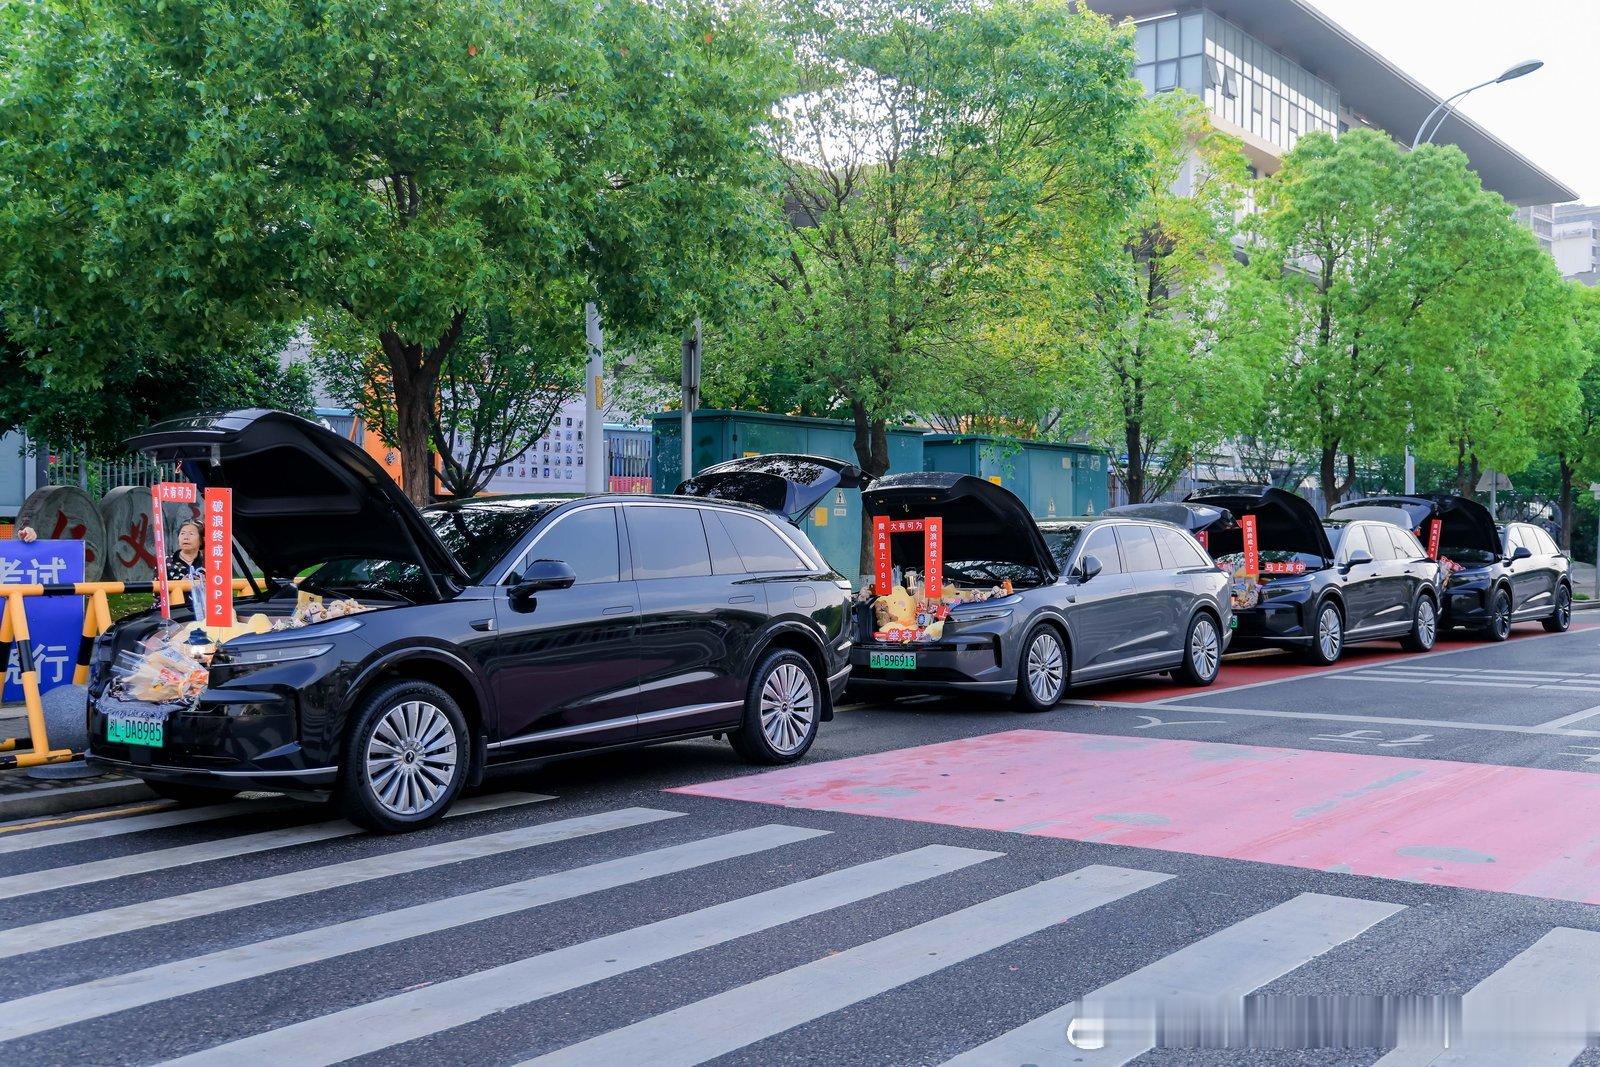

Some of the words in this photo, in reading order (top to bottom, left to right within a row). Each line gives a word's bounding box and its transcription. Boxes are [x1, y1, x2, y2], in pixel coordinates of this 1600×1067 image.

[163, 486, 192, 499] 大有可为
[891, 521, 923, 531] 大有可为
[211, 500, 224, 615] 破浪终成TOP2
[929, 524, 938, 592] 破浪终成TOP2
